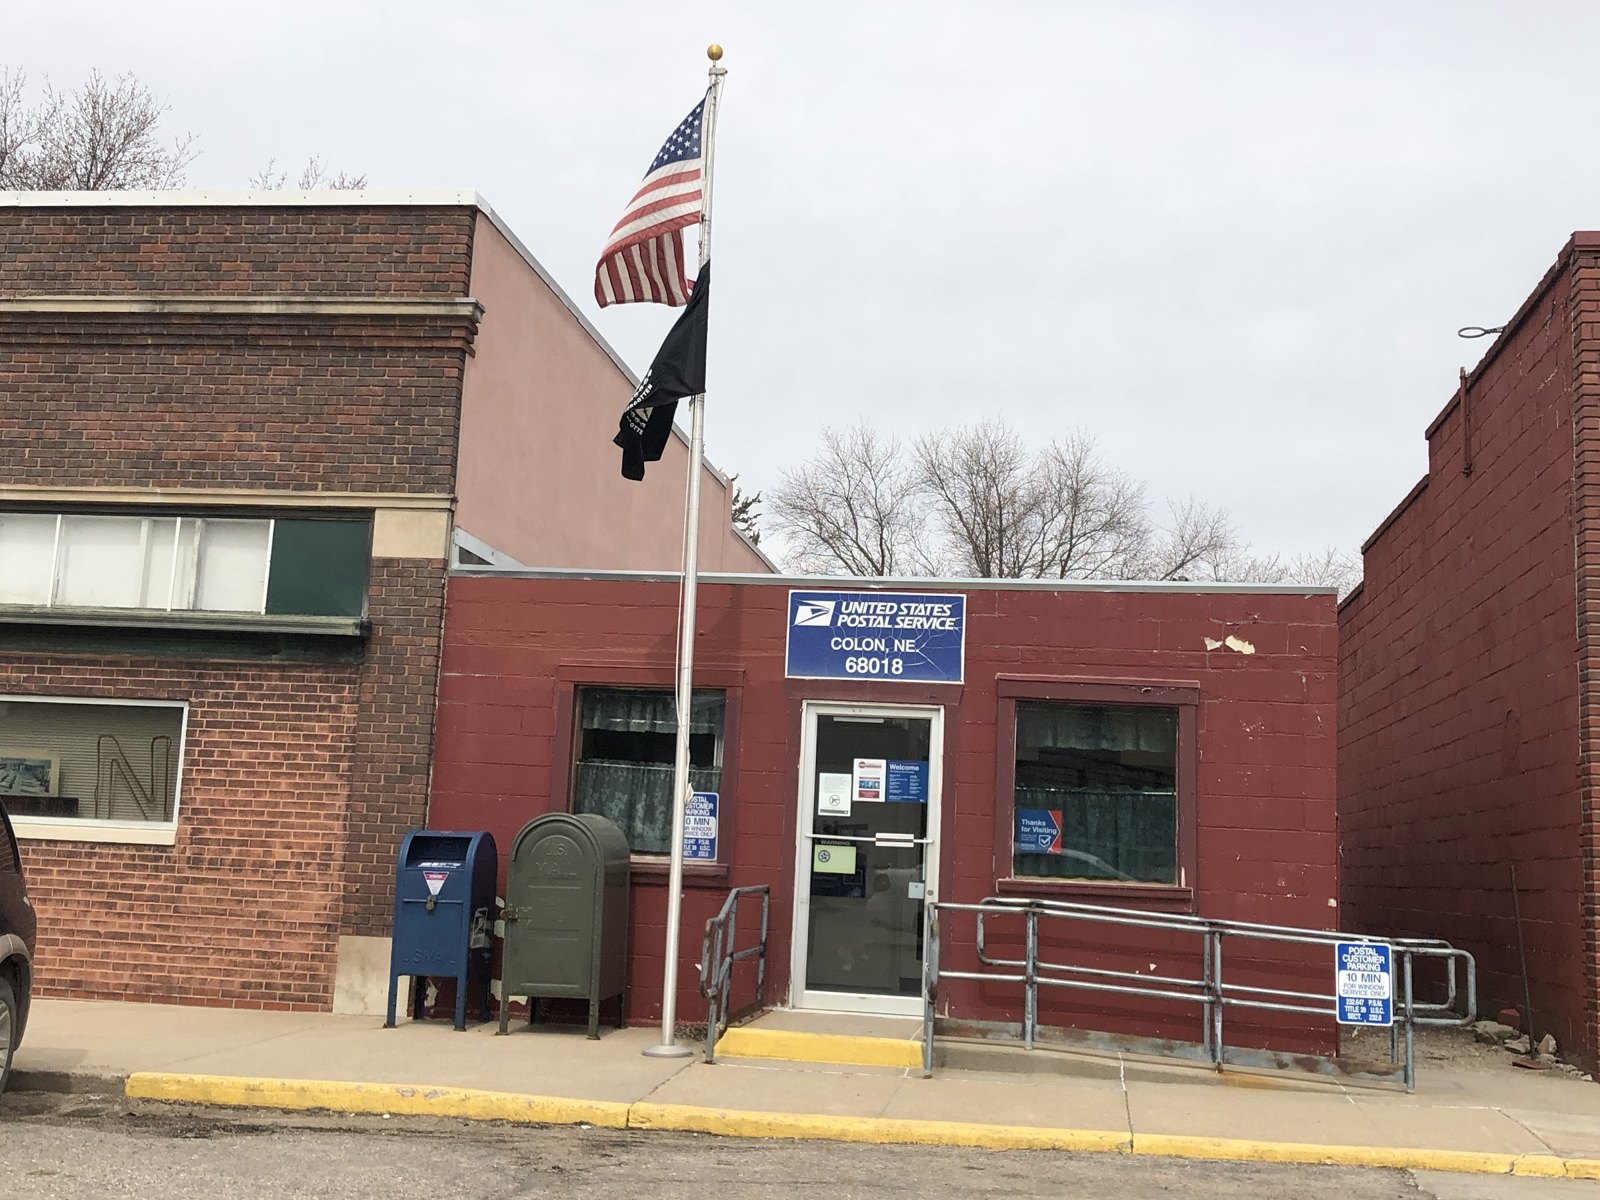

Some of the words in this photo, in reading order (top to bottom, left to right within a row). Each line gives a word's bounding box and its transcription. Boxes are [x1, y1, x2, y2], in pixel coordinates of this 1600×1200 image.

[841, 601, 897, 615] UNITED
[898, 602, 952, 616] STATES
[837, 614, 892, 628] POSTAL
[894, 616, 956, 630] SERVICE
[830, 637, 890, 654] COLON,
[845, 656, 904, 674] 68018
[1021, 818, 1046, 827] Thanks
[1032, 827, 1057, 836] Visiting
[1348, 946, 1379, 956] POSTAL
[1342, 954, 1386, 964] CUSTOMER
[1346, 962, 1380, 972] PARKING
[1346, 972, 1358, 982] 10
[1361, 974, 1381, 983] MIN
